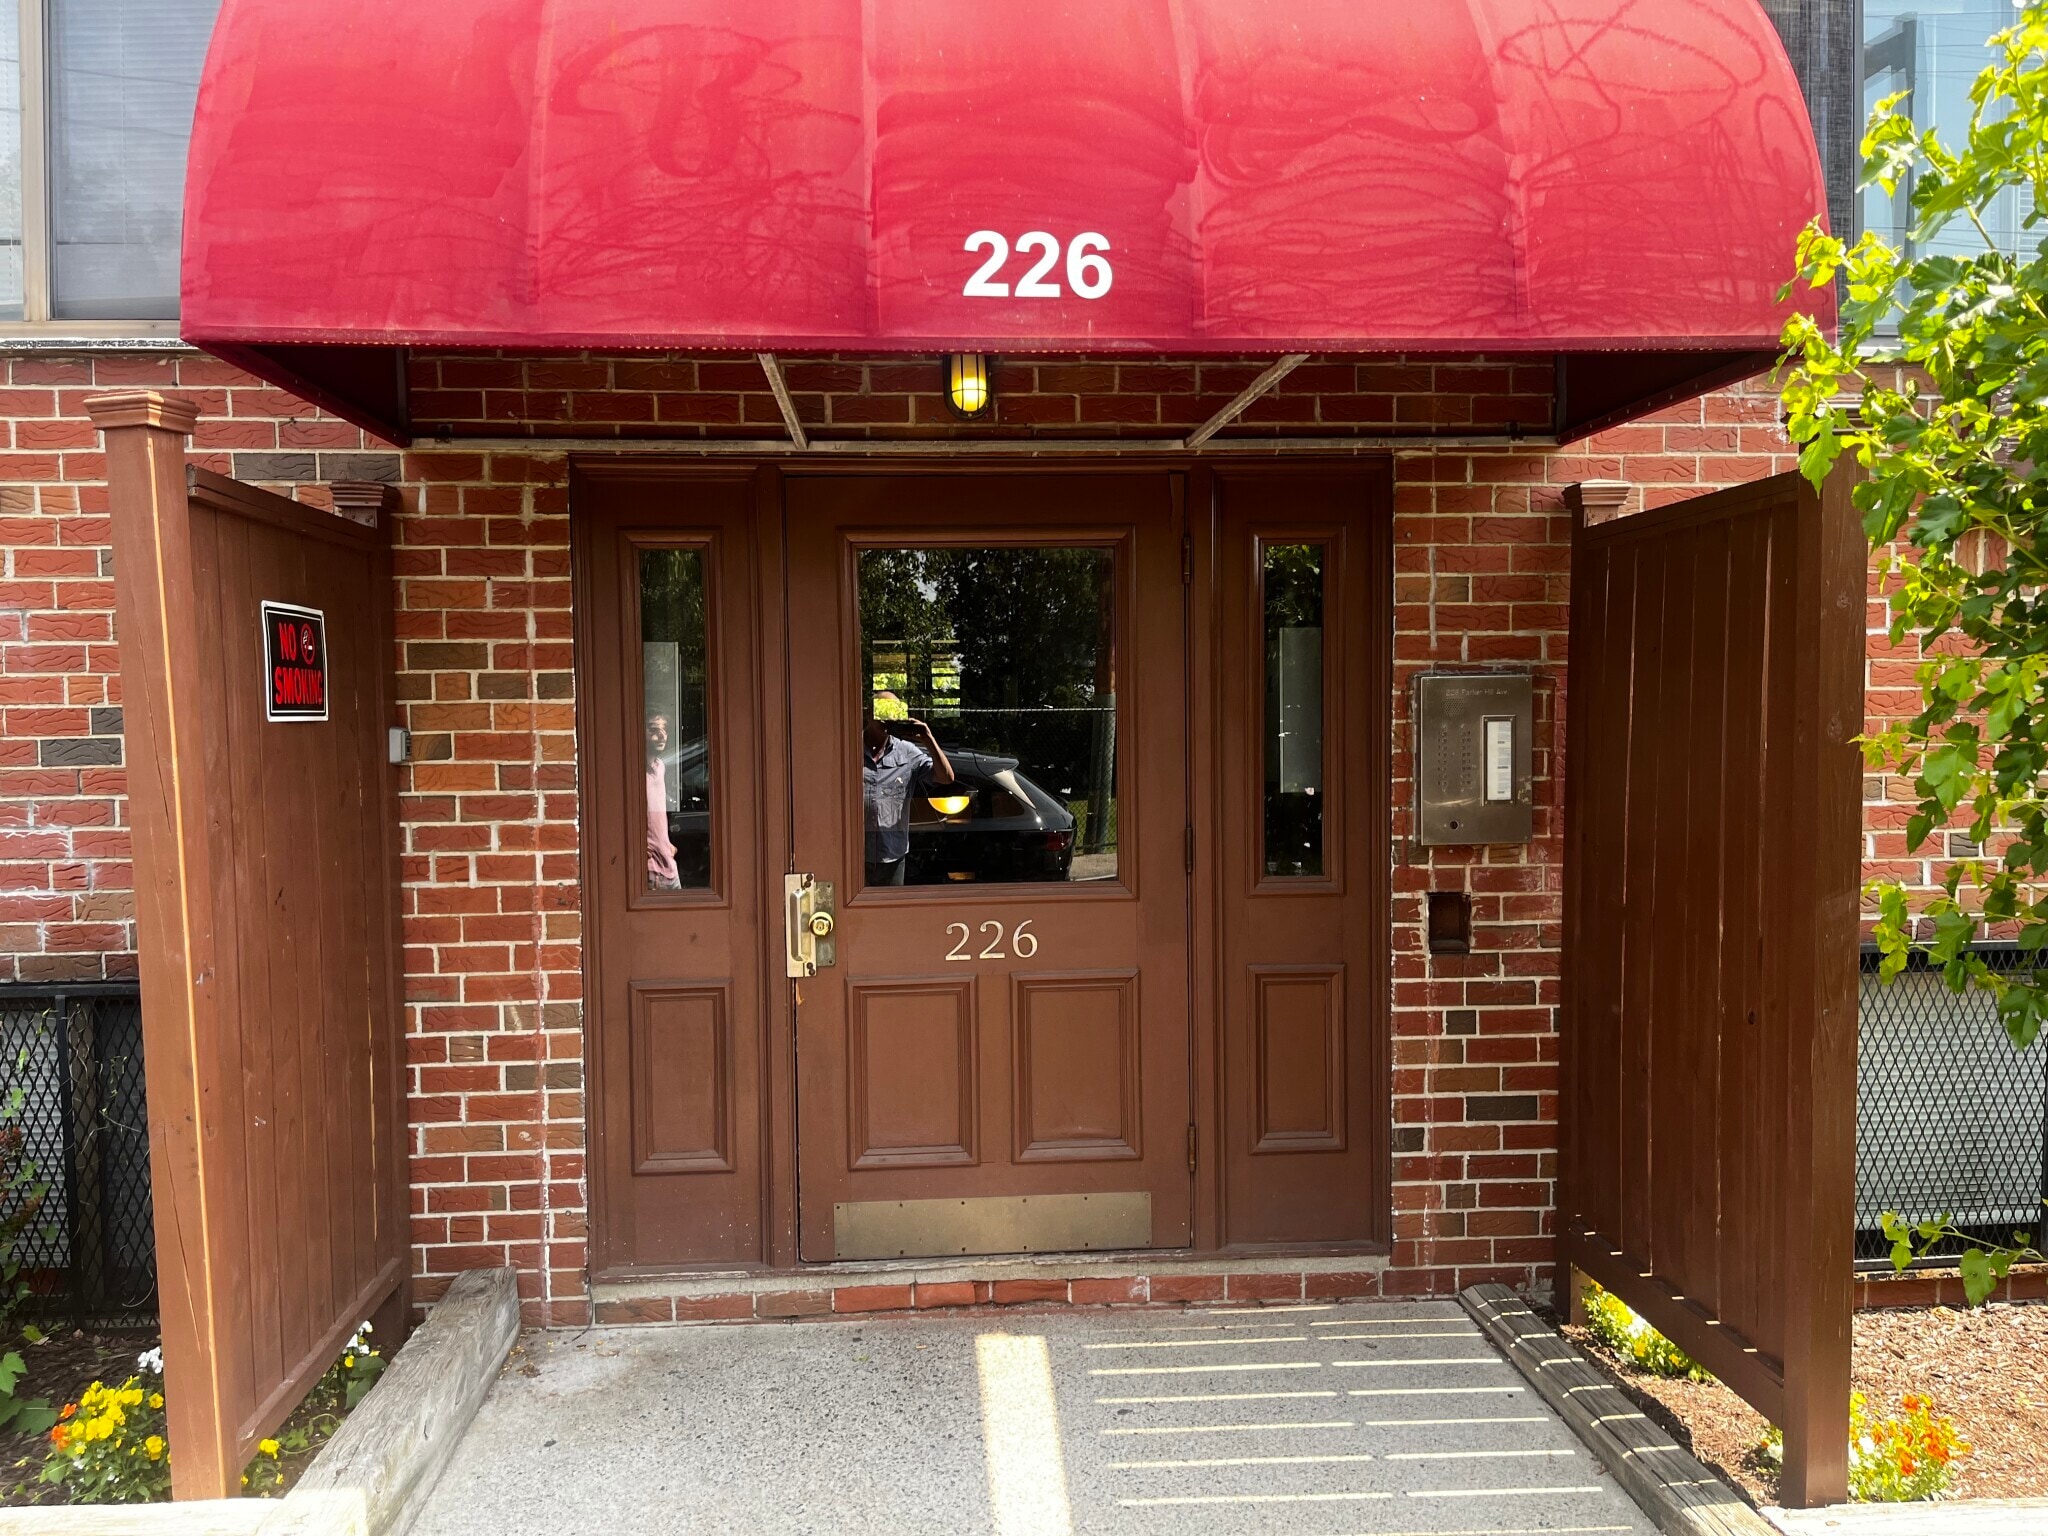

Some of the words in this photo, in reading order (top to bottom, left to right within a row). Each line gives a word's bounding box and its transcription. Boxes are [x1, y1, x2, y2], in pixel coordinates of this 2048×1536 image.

[963, 230, 1113, 299] 226
[278, 622, 297, 661] NO
[274, 666, 323, 705] SMOKING
[945, 919, 1038, 961] 226
